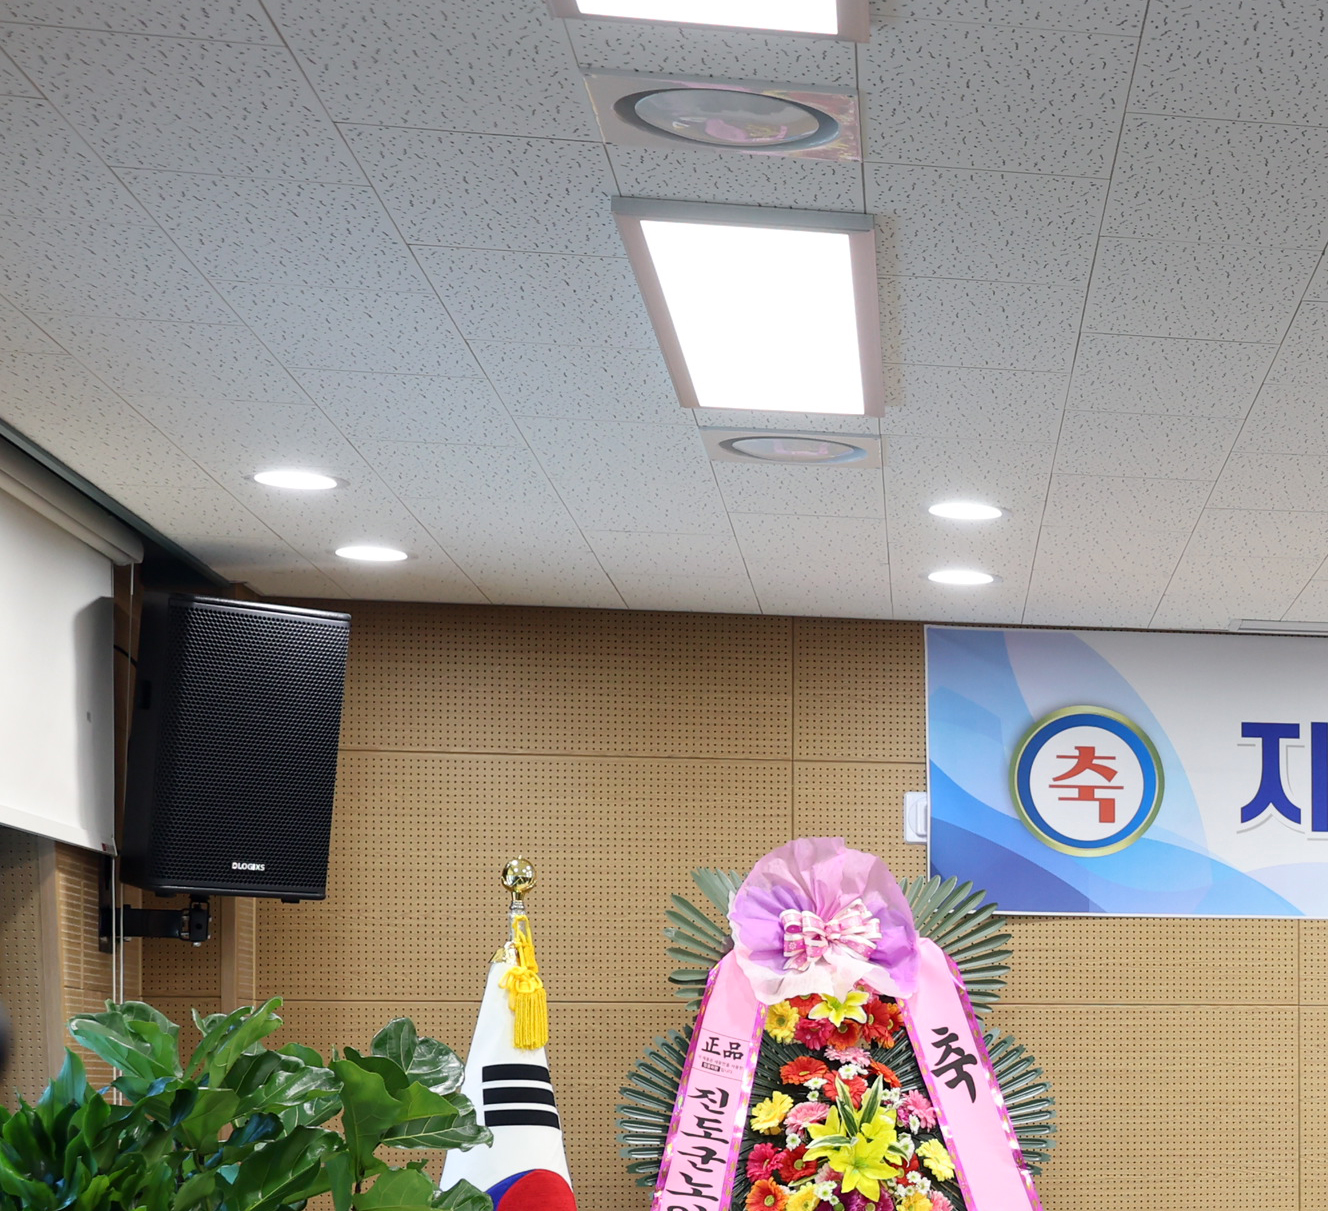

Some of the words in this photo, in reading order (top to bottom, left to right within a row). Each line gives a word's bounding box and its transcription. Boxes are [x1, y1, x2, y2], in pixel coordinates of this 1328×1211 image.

[1050, 746, 1124, 824] 축
[701, 1036, 744, 1060] 正品
[929, 1026, 979, 1104] 축
